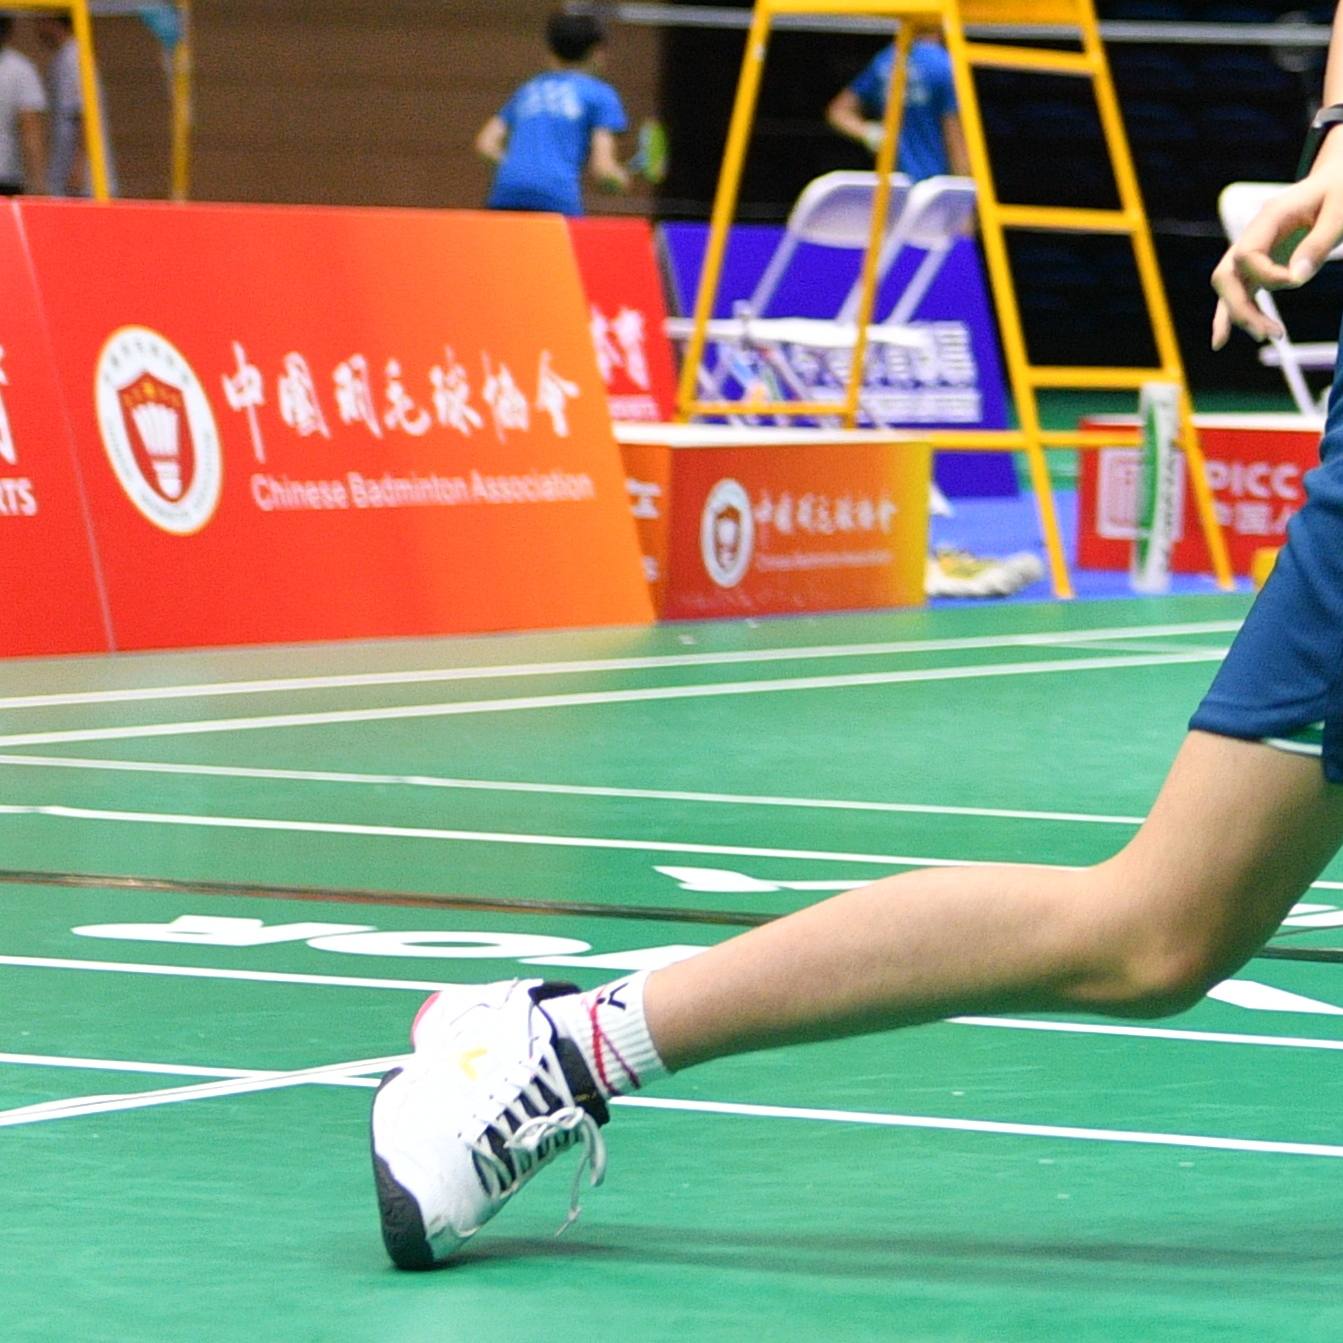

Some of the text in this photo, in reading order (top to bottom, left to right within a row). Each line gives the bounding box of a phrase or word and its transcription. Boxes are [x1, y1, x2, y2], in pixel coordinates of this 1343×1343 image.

[250, 473, 349, 512] Chinese
[347, 471, 468, 509] Badminton
[471, 469, 596, 506] Association
[1204, 460, 1299, 500] PICC
